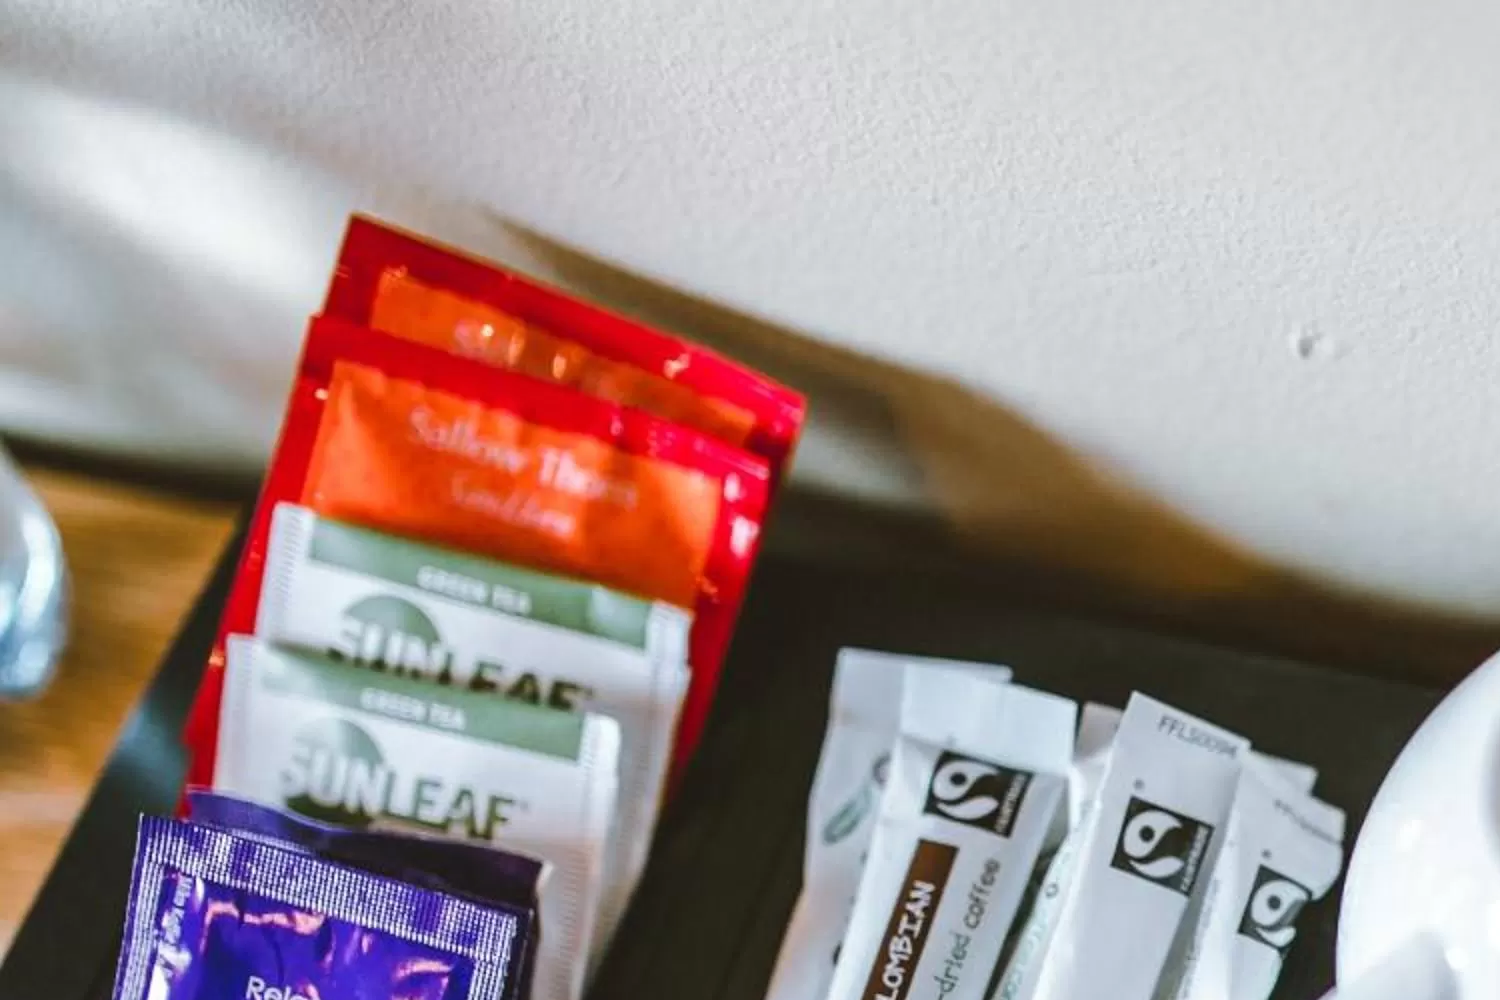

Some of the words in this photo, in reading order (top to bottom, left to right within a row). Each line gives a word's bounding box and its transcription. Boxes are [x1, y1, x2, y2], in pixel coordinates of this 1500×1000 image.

[417, 565, 489, 603] GREEN
[492, 584, 532, 616] TEA
[360, 686, 428, 722] GREEN
[428, 703, 467, 731] TEA
[281, 744, 514, 841] SUNLEAF
[963, 858, 1002, 930] coffee
